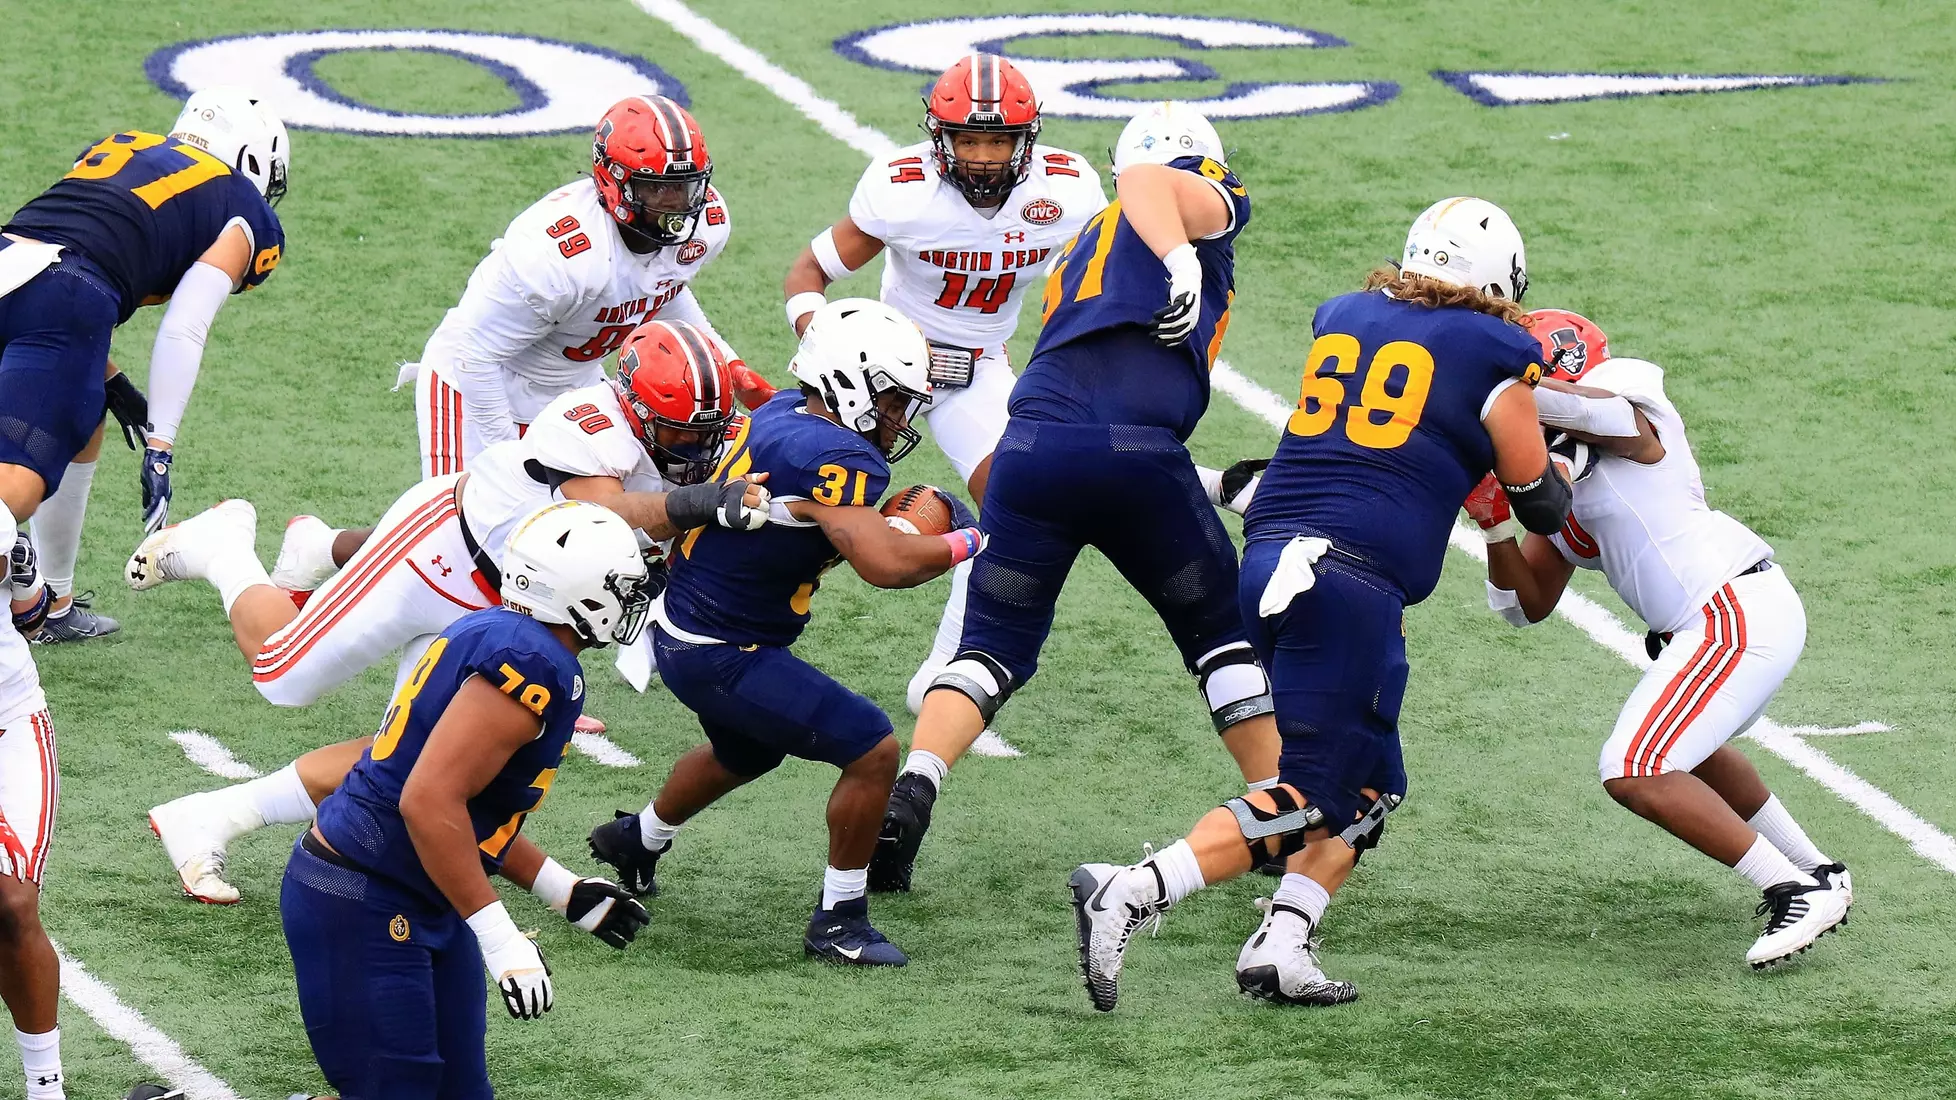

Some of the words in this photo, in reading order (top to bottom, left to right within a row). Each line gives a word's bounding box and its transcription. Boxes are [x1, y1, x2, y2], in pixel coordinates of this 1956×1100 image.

[975, 113, 995, 122] UNITY
[187, 133, 210, 150] STATE
[63, 129, 232, 210] 87
[673, 163, 691, 171] UNITY
[888, 156, 925, 183] 14
[1043, 153, 1080, 178] 14
[1029, 206, 1055, 218] OVC
[546, 215, 592, 259] 99
[918, 250, 993, 272] AUSTIN
[934, 271, 1017, 315] 14
[1287, 333, 1435, 450] 69
[563, 403, 615, 436] 90
[699, 411, 718, 421] UNITY
[812, 463, 868, 507] 31
[509, 600, 533, 617] STATE
[498, 662, 551, 716] 78
